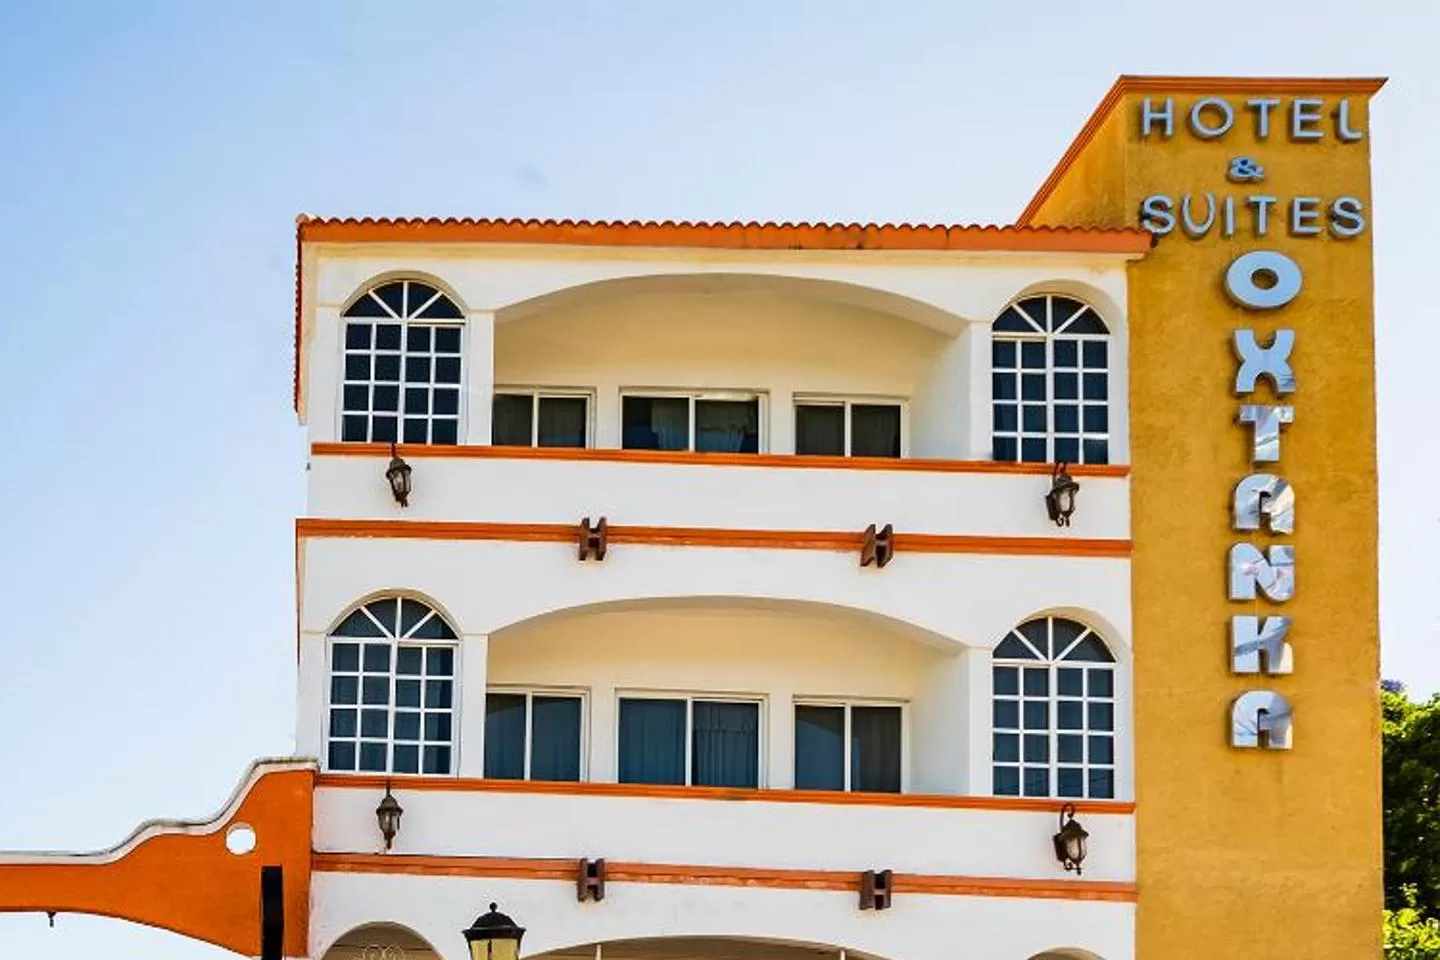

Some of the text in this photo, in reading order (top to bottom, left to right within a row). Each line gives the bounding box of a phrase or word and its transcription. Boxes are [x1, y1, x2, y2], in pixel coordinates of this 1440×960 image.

[1140, 97, 1363, 141] HOTEL
[1227, 155, 1265, 183] &
[1140, 193, 1366, 240] SUITES
[1224, 249, 1304, 749] OXTANKA
